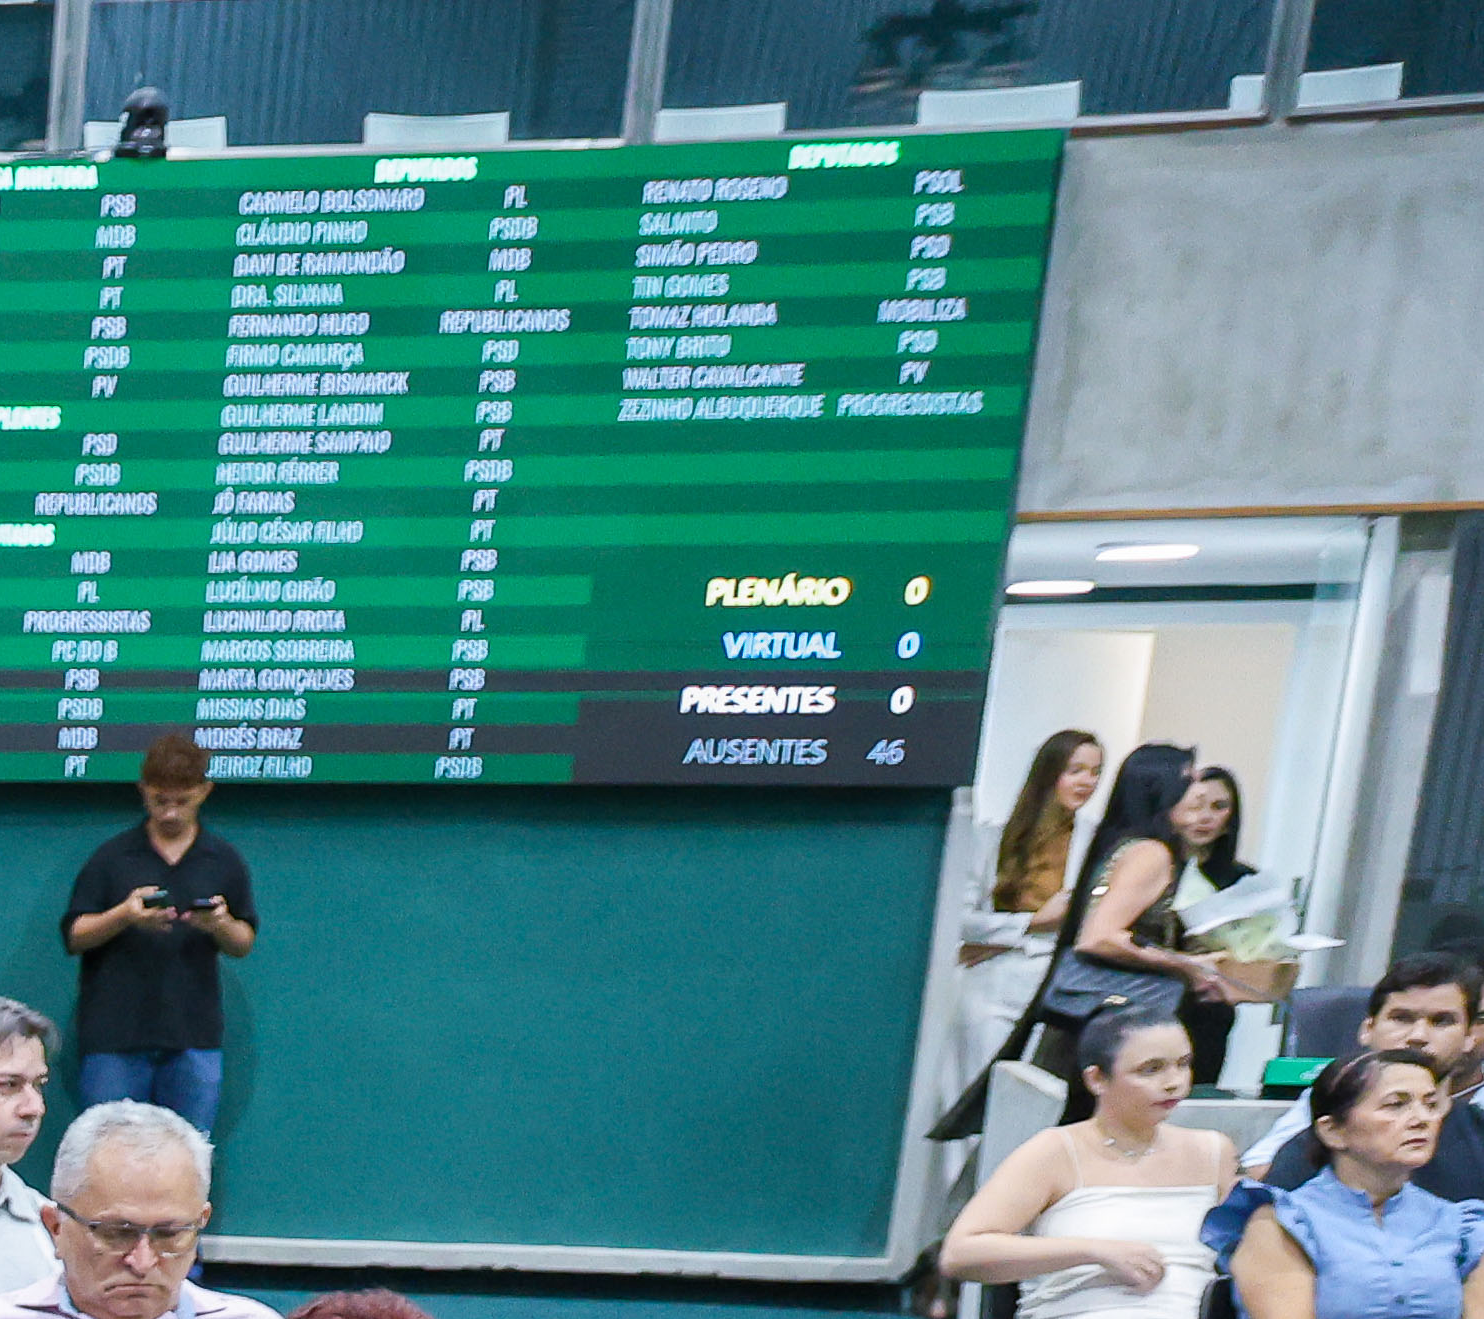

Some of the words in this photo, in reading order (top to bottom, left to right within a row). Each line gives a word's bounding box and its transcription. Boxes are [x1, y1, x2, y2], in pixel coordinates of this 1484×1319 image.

[101, 194, 136, 217] PSB
[504, 185, 527, 208] PL
[96, 225, 136, 248] MDB
[489, 216, 538, 240] PSDB
[103, 256, 127, 278] PT
[489, 248, 531, 271] MDB
[100, 287, 123, 308] PT
[495, 280, 518, 302] PL
[91, 316, 126, 339] PSB
[84, 346, 129, 368] PSDB
[482, 340, 519, 362] PSD
[92, 376, 117, 397] PV
[479, 370, 516, 392] PSB
[476, 401, 512, 423] PSB
[82, 434, 117, 456] PSD
[479, 429, 505, 451] PT
[75, 463, 120, 485] PSDB
[465, 460, 512, 482] PSDB
[473, 489, 498, 511] PT
[470, 520, 495, 541] PT
[71, 551, 110, 573] MDB
[461, 549, 497, 571] PSB
[78, 581, 99, 603] PL
[458, 580, 493, 601] PSB
[706, 573, 853, 606] PLENÁRIO
[905, 576, 930, 605] 0
[461, 610, 484, 631] PL
[452, 640, 488, 661] PSB
[723, 632, 841, 659] VIRTUAL
[899, 632, 920, 658] 0
[65, 669, 99, 690] PSB
[449, 669, 485, 690] PSB
[58, 698, 102, 720] PSDB
[452, 698, 477, 719] PT
[680, 685, 836, 713] PRESENTES
[891, 686, 914, 714] 0
[58, 727, 97, 749] MDB
[449, 728, 474, 749] PT
[683, 738, 827, 764] AUSENTES
[867, 739, 905, 764] 46
[65, 755, 88, 776] PT
[205, 756, 264, 777] UEIROZ
[435, 757, 482, 778] PSDB
